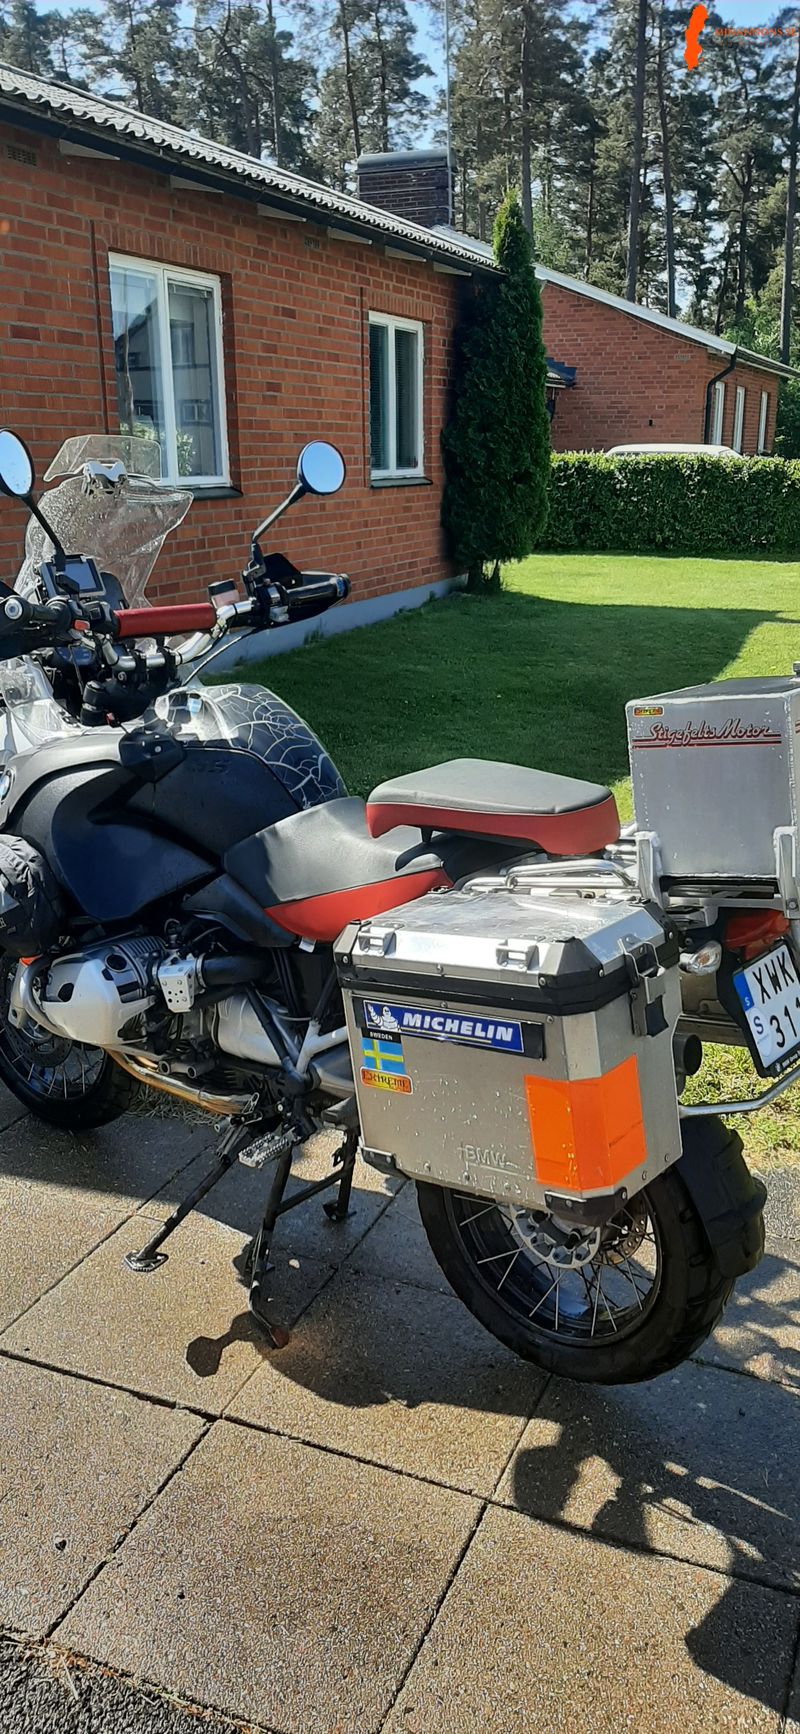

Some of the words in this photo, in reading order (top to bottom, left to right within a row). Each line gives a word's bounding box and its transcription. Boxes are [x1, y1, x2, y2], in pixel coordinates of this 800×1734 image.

[650, 720, 717, 747] Stigefelts
[717, 718, 770, 738] Motor
[752, 951, 795, 1005] XWK
[744, 996, 751, 1007] S
[403, 1012, 513, 1042] MICHELIN
[753, 1015, 764, 1035] S
[769, 996, 800, 1049] 31
[369, 1031, 393, 1041] SWEDEN
[465, 1144, 508, 1168] BMW
